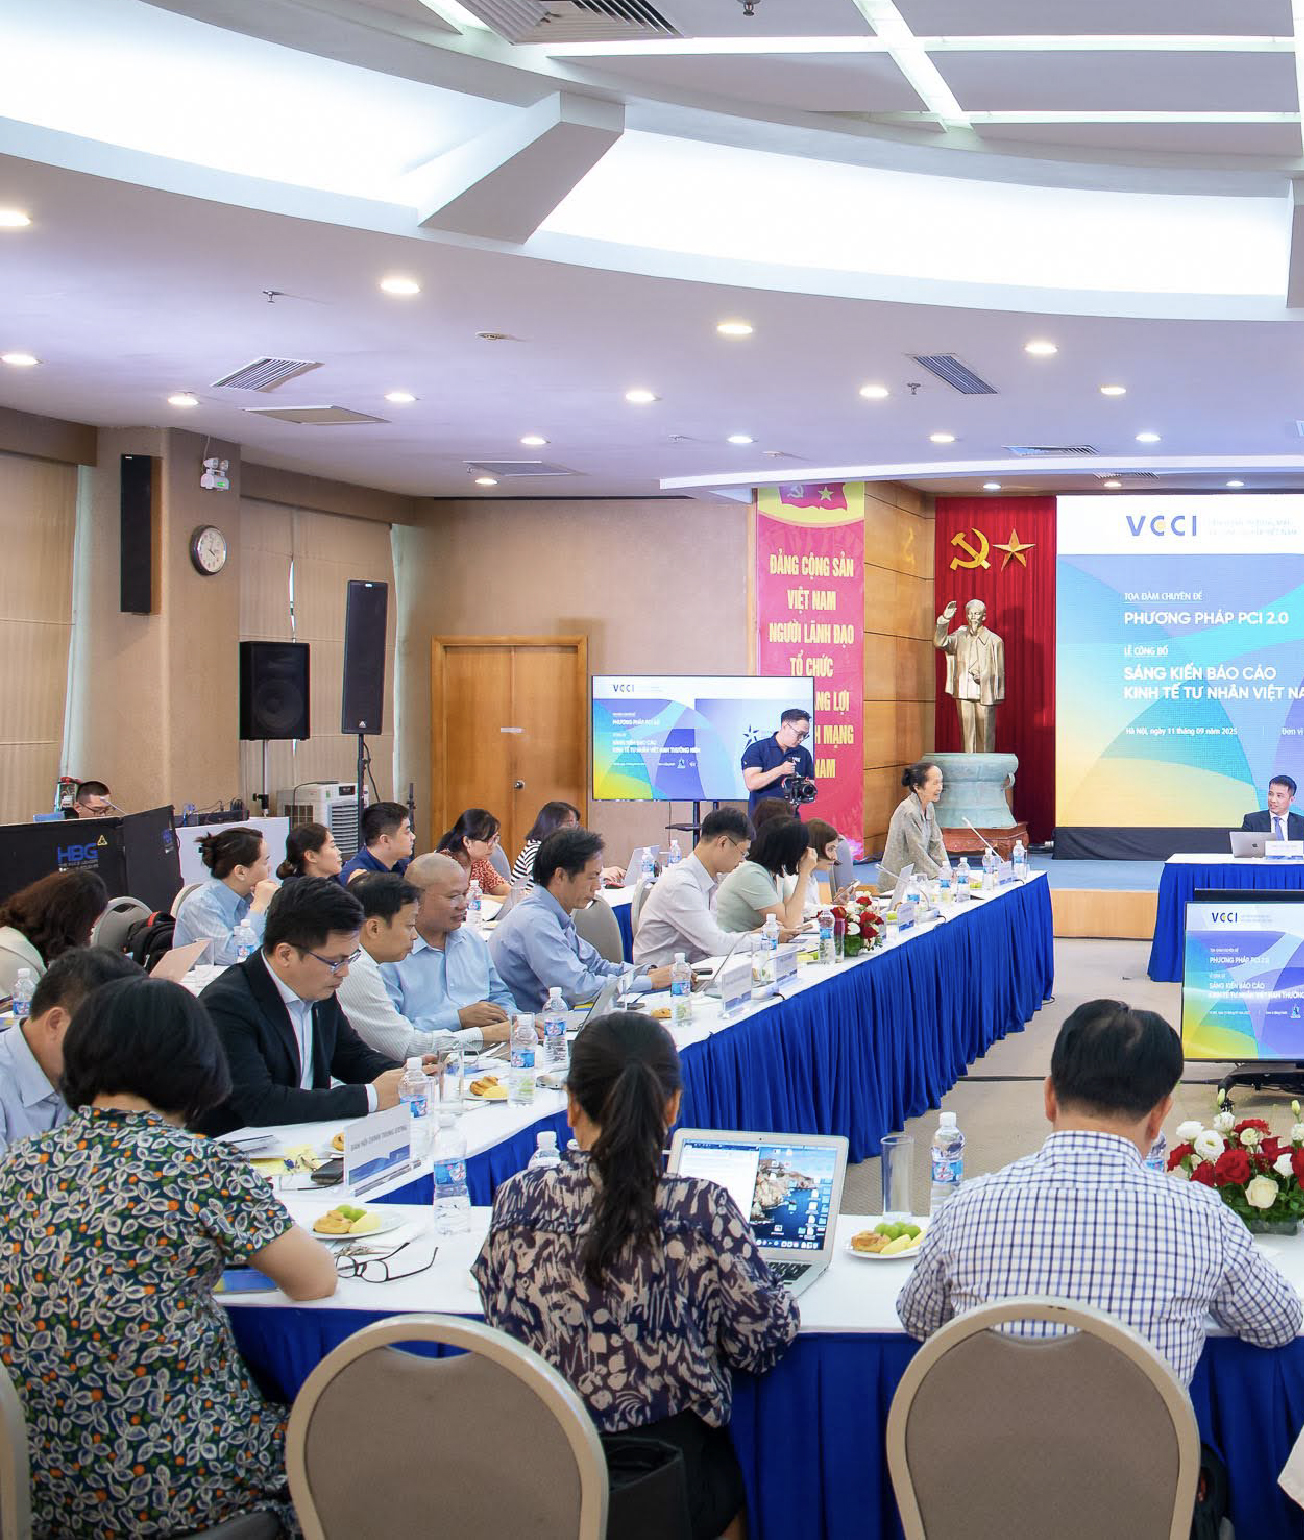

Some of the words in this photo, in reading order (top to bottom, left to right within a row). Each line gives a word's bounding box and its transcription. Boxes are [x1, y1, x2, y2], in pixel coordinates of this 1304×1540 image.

[1125, 515, 1197, 537] VCCI
[769, 548, 799, 575] ĐẢNG
[801, 552, 830, 580] CỘNG
[832, 551, 854, 577] SẢN
[787, 586, 809, 614] VIỆT
[812, 591, 836, 610] NAM
[1124, 610, 1191, 625] PHƯƠNG
[1195, 607, 1235, 625] PHÁP
[1238, 611, 1262, 625] PCI
[1266, 611, 1289, 625] 2.0
[769, 618, 801, 643] NGƯỜI
[804, 620, 831, 644] LÃNH
[833, 624, 854, 648] ĐẠO
[790, 650, 803, 676] TỔ
[806, 655, 834, 677] CHỨC
[1124, 663, 1167, 681] SÁNG
[1170, 662, 1203, 681] KIẾN
[1207, 663, 1239, 681] BÁO
[1243, 663, 1277, 681] CÁO
[834, 691, 850, 715] LỢI
[1124, 686, 1158, 700] KINH
[1163, 682, 1181, 700] TẾ
[1184, 686, 1204, 700] TƯ
[1207, 683, 1249, 700] NHÂN
[1252, 683, 1285, 702] VIỆT
[824, 725, 854, 748] MẠNG
[57, 843, 99, 864] HBG
[1211, 912, 1238, 923] VCCI
